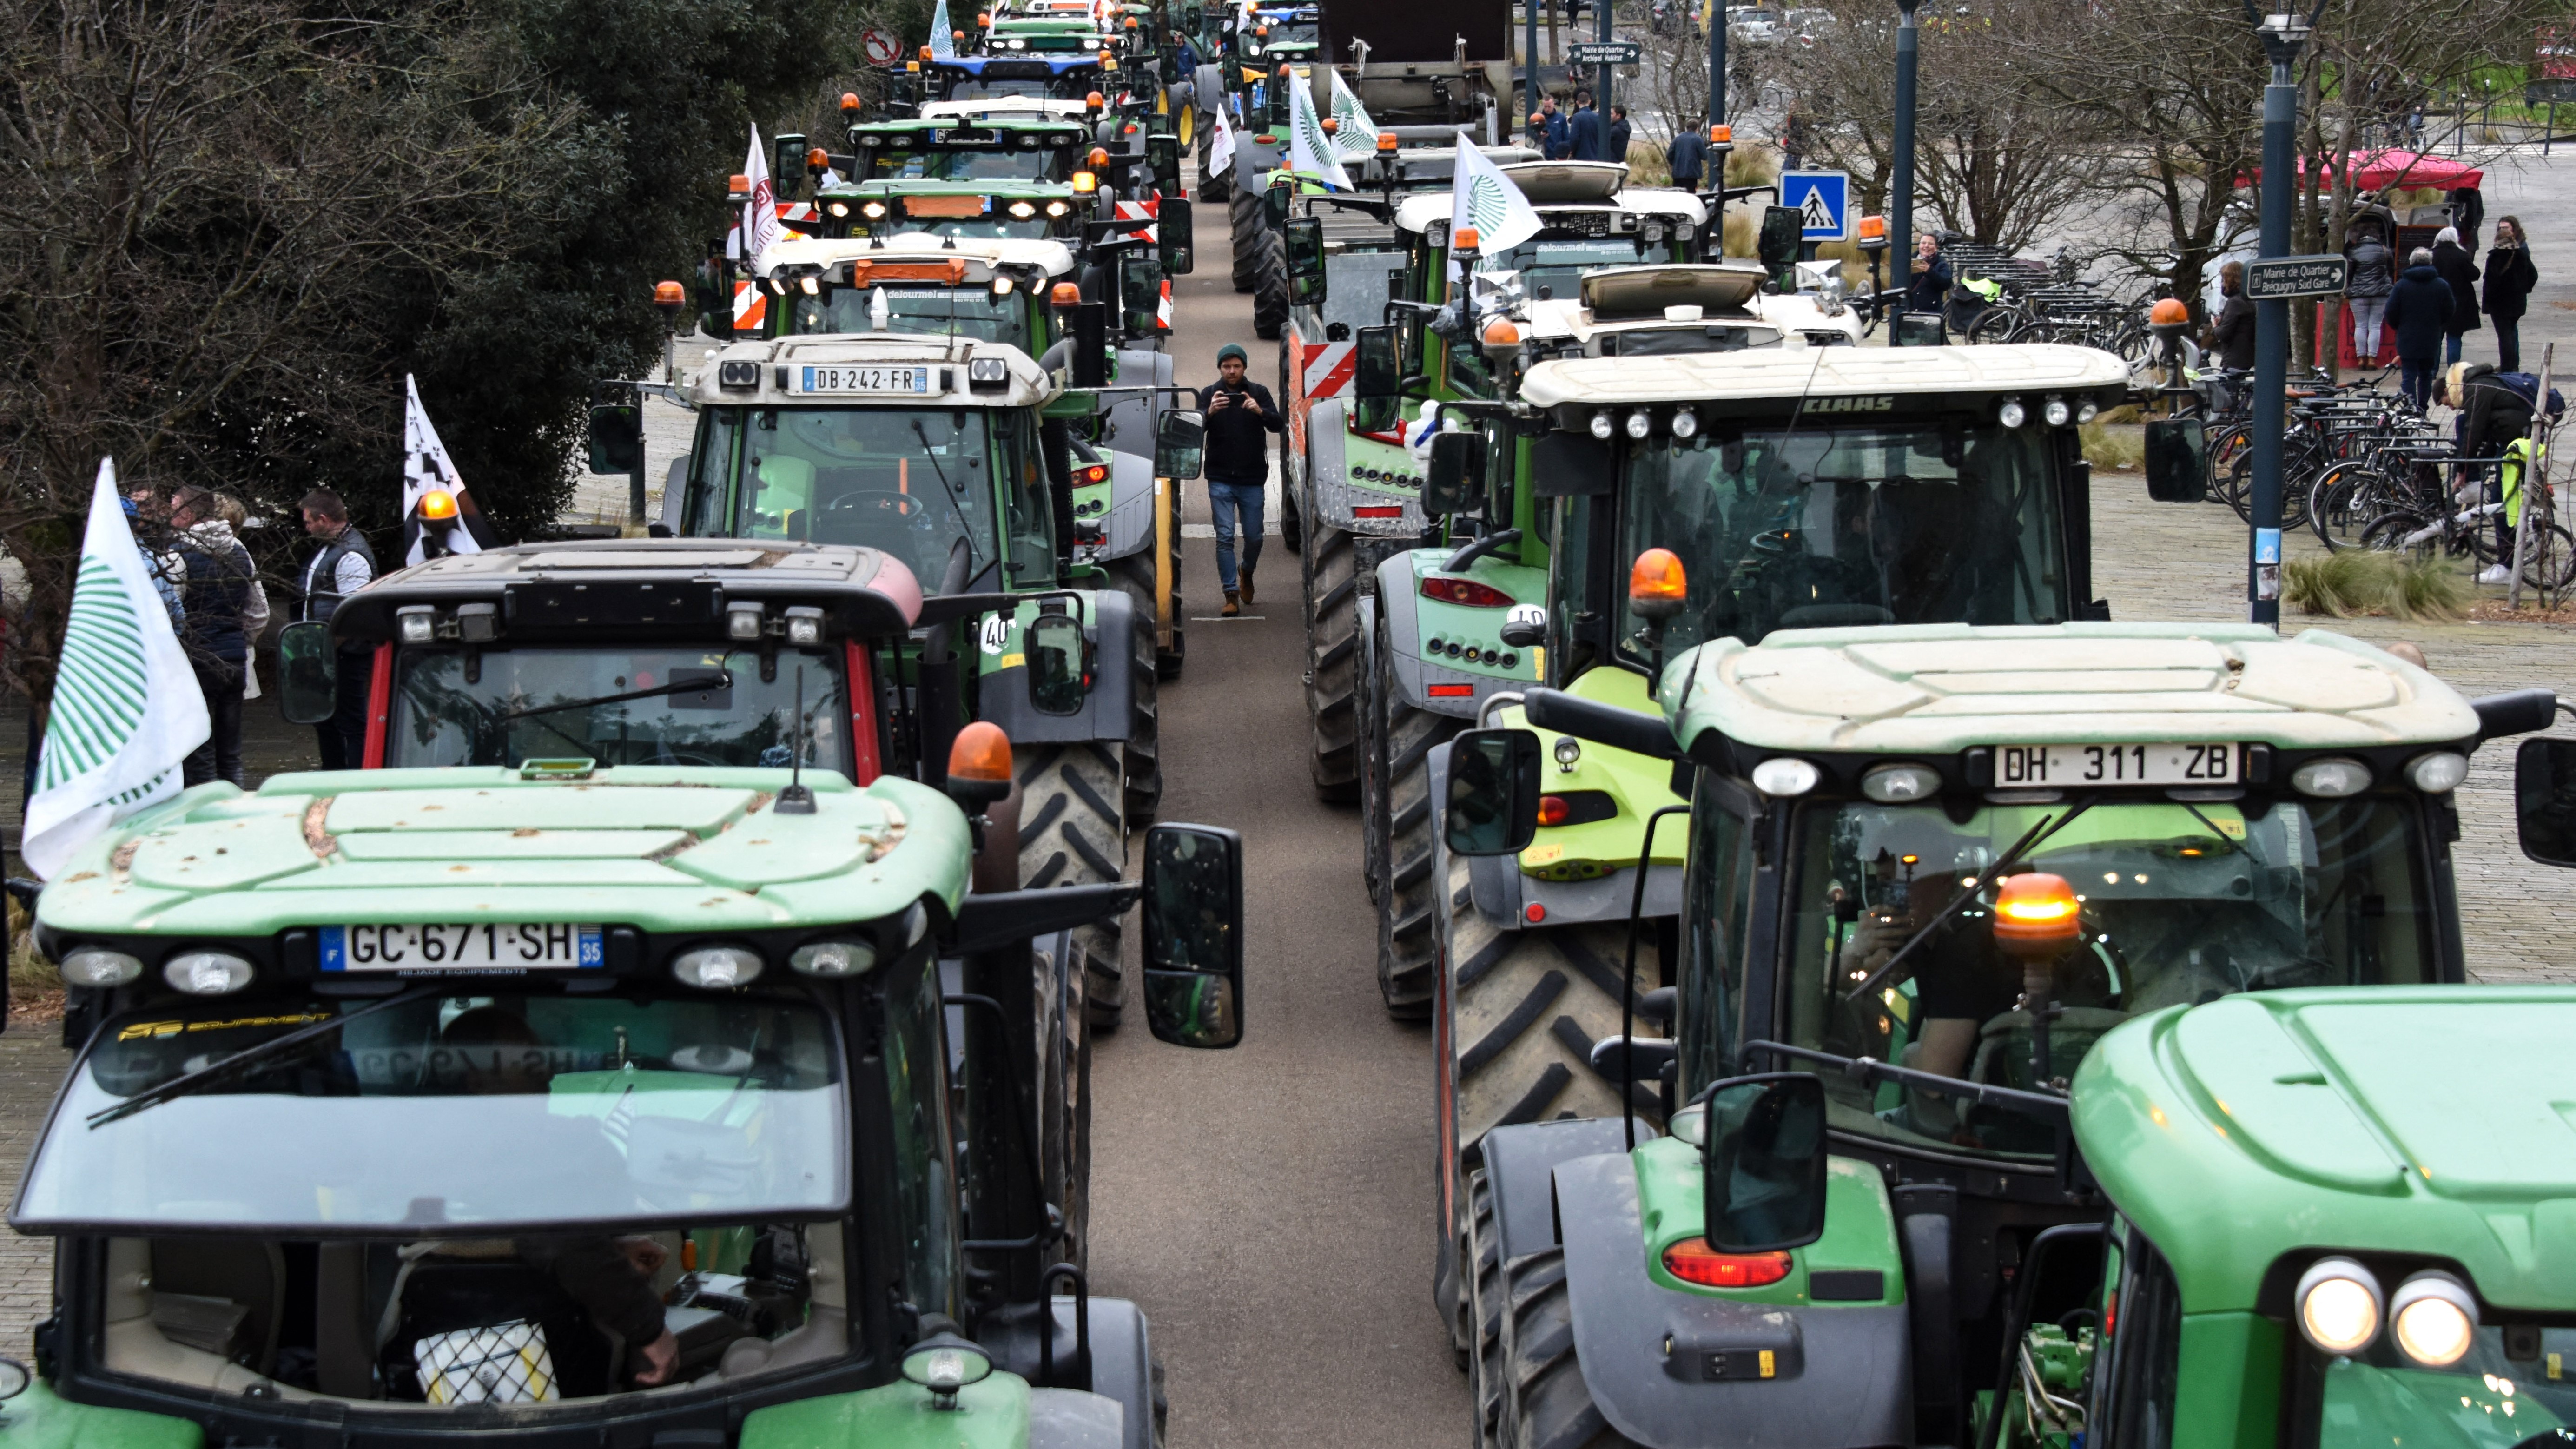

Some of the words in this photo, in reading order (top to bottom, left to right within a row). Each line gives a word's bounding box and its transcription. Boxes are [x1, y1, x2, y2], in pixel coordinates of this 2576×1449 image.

[1582, 54, 1602, 63] Archipel
[1537, 243, 1585, 252] delourmel
[2263, 266, 2285, 278] Mairie
[2288, 265, 2298, 277] de
[2300, 264, 2330, 278] Quartier
[887, 290, 937, 298] delourmel
[2262, 279, 2297, 294] Bréquigny
[2298, 278, 2312, 290] Sud
[2313, 278, 2330, 288] Gare
[818, 371, 912, 389] DB-242-FR
[915, 381, 925, 390] 35
[1802, 397, 1893, 413] CLAAS
[986, 620, 1008, 647] 40
[2004, 747, 2046, 781] DH
[2083, 745, 2145, 780] 311
[2185, 744, 2227, 779] ZB
[329, 949, 337, 961] F
[351, 923, 572, 963] GC-671-SH
[582, 942, 600, 962] 35
[187, 1013, 331, 1032] EQUIPEMENT
